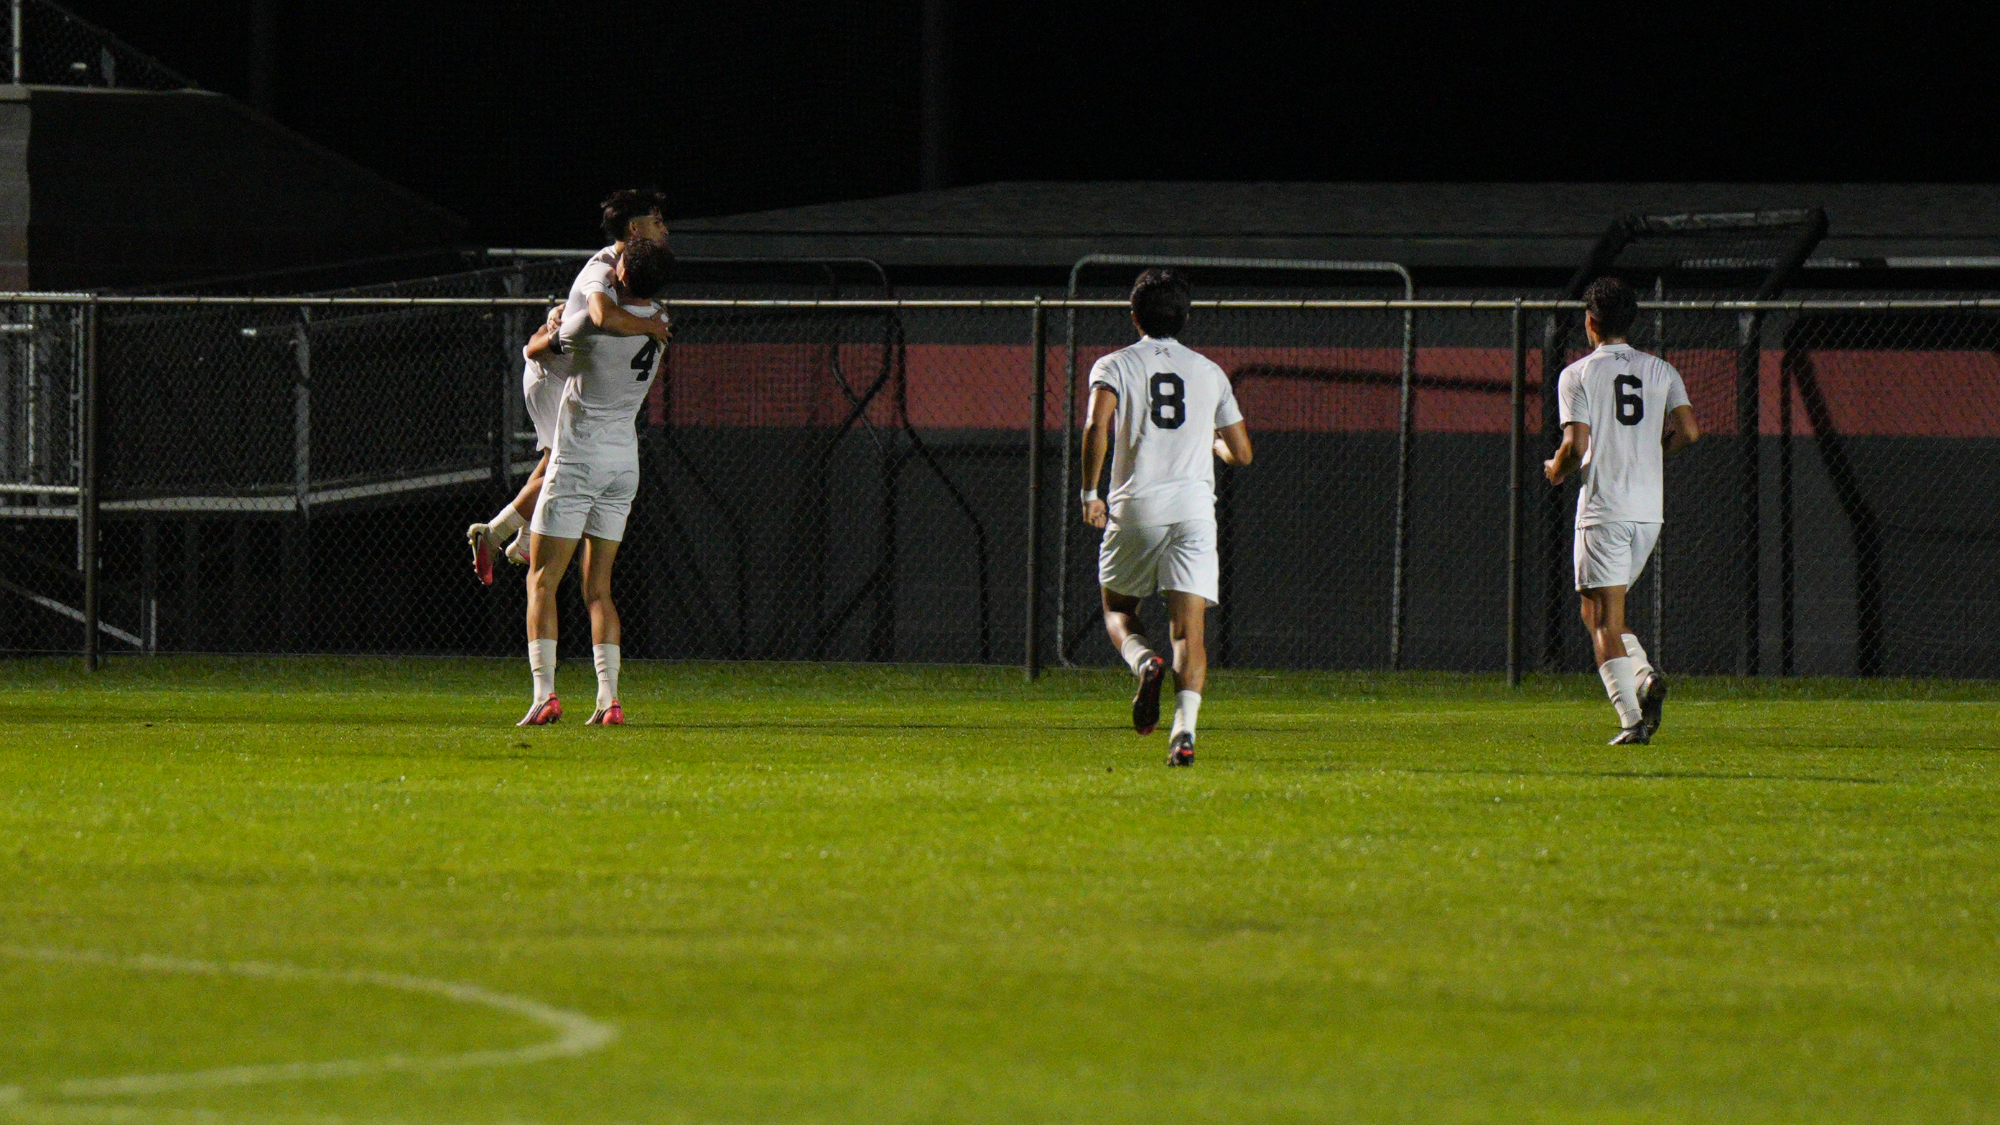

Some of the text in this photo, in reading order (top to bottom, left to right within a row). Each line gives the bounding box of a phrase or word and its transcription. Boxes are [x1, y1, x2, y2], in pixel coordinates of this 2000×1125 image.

[631, 336, 657, 381] 4
[1150, 372, 1186, 429] 8
[1614, 373, 1644, 426] 6
